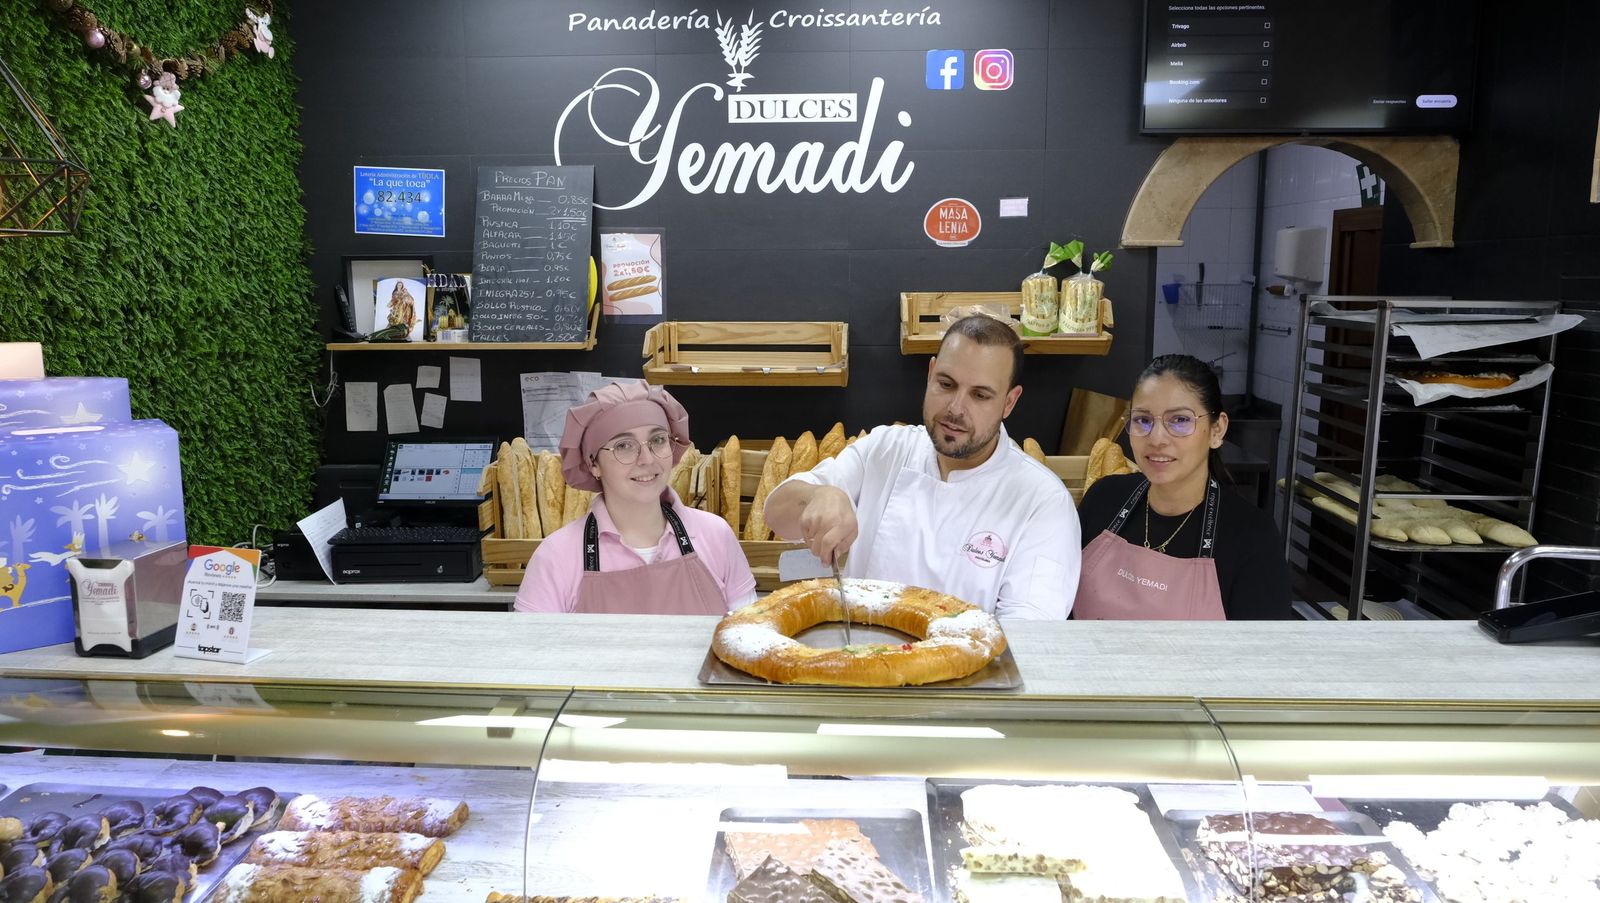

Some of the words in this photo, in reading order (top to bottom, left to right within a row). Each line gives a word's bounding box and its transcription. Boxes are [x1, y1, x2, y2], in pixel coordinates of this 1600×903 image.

[568, 9, 709, 32] Panadería
[768, 6, 942, 29] Croissantería
[735, 99, 852, 120] DULCES
[554, 67, 915, 211] Yemadi
[386, 180, 404, 188] que
[531, 171, 568, 188] PAN
[377, 190, 422, 203] 82.434
[939, 208, 969, 220] MASA
[939, 221, 969, 234] LENTA
[612, 259, 650, 268] PROMOCIÓN
[204, 559, 241, 576] Google
[1136, 577, 1169, 592] YEMADI
